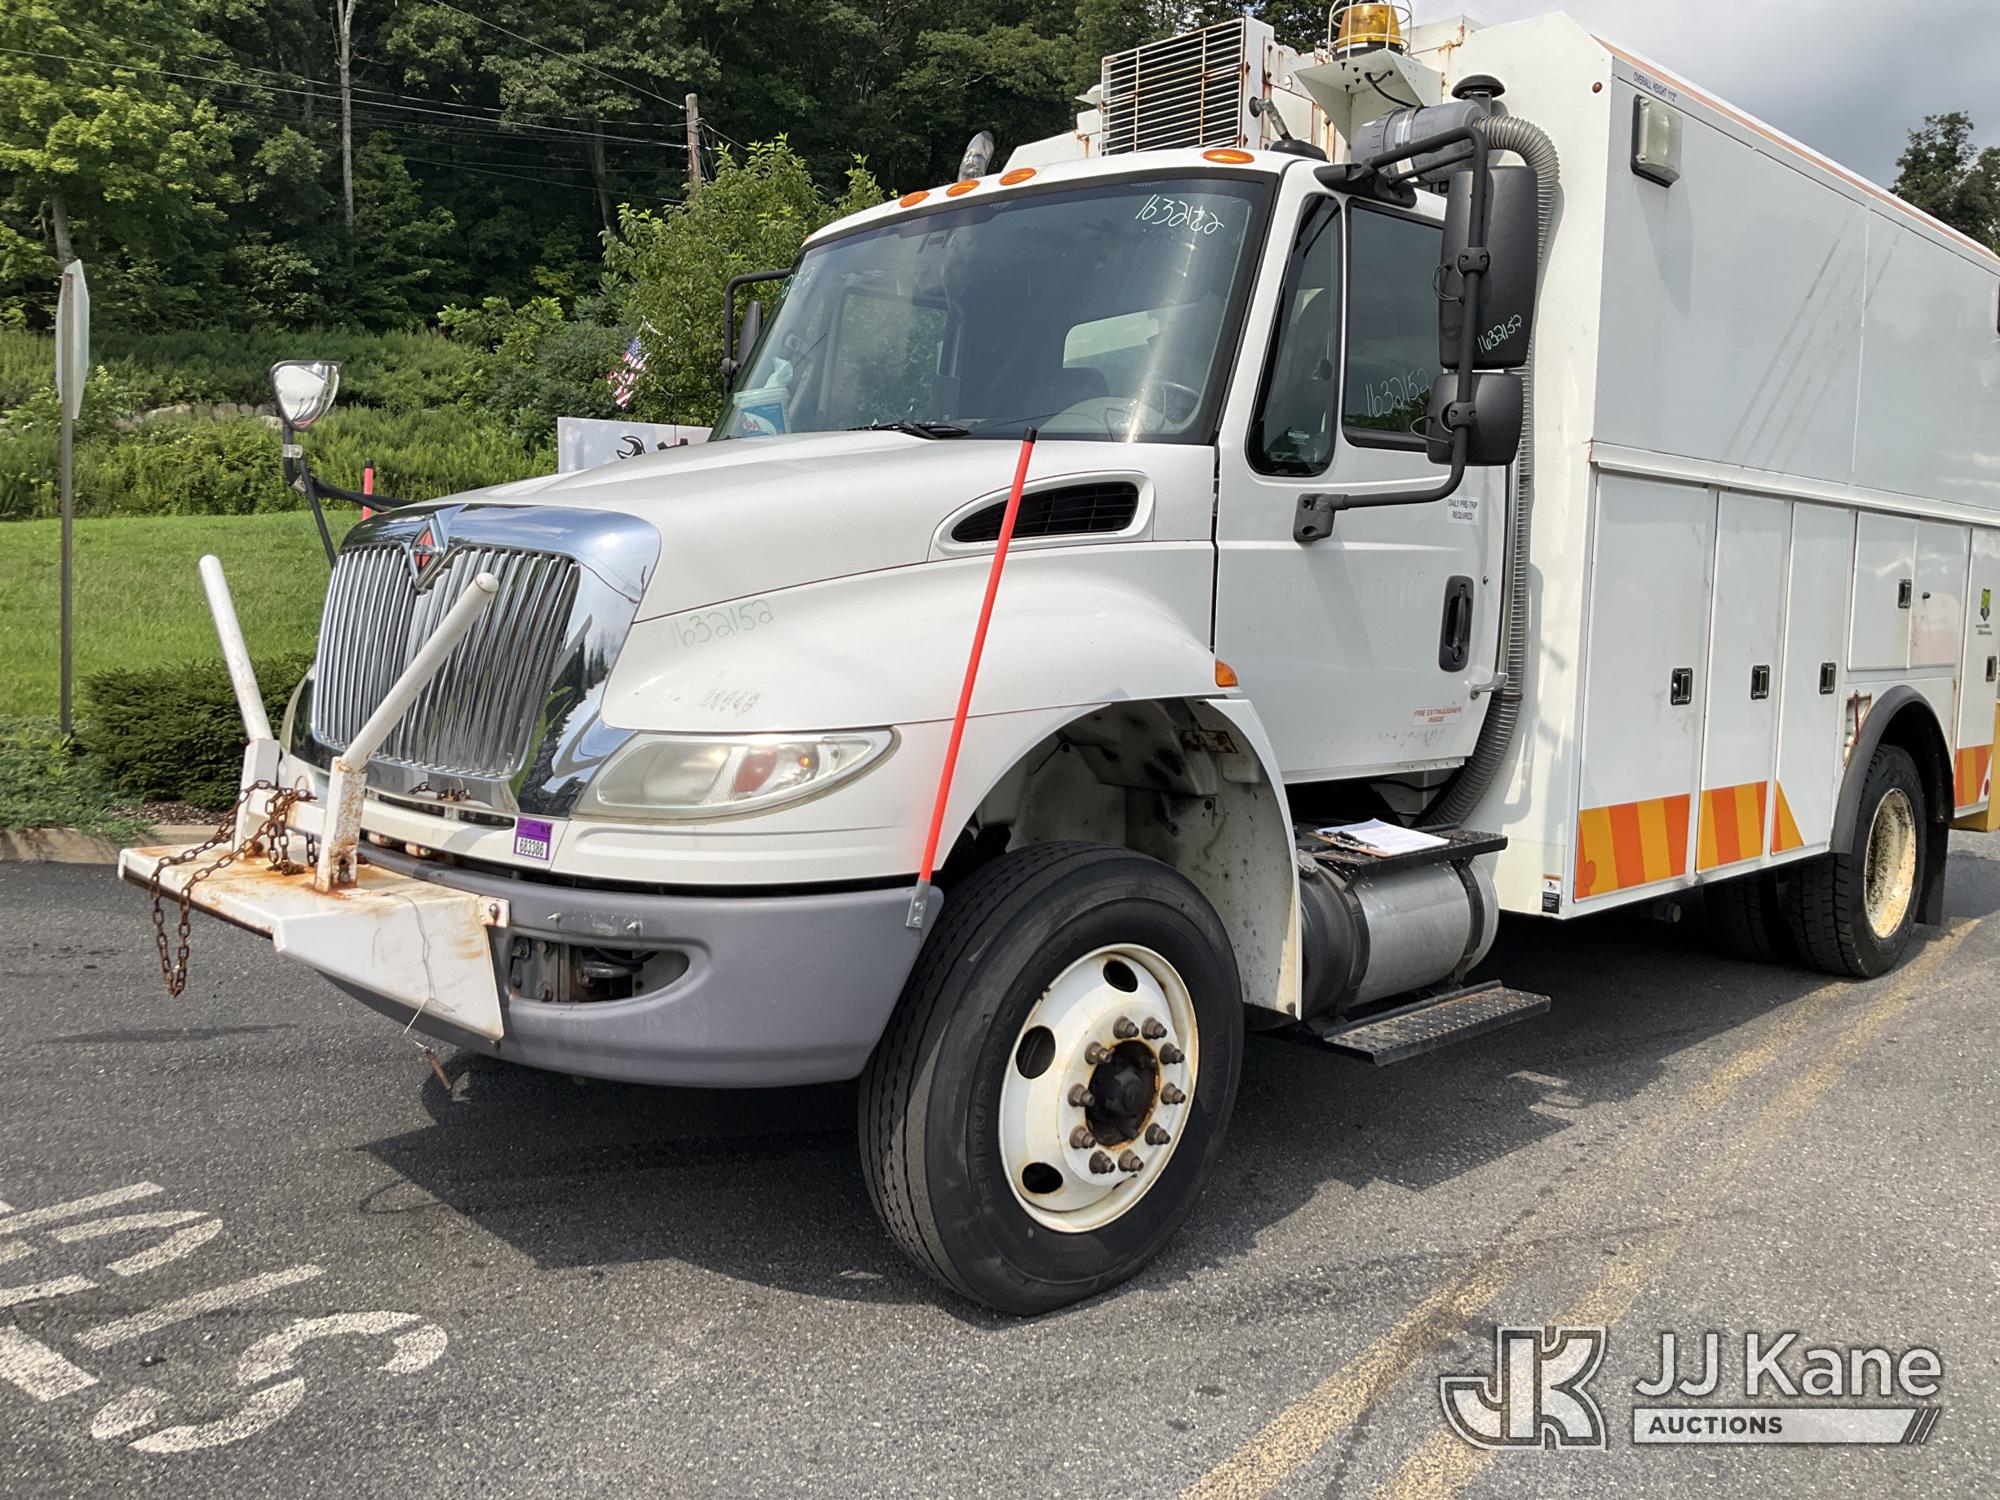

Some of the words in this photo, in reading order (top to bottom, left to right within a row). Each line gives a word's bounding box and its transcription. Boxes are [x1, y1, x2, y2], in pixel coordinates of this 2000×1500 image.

[1477, 314, 1521, 354] 1632152
[1447, 499, 1460, 508] DAILY
[1452, 510, 1473, 521] REQUIRED
[669, 599, 774, 648] 1632152
